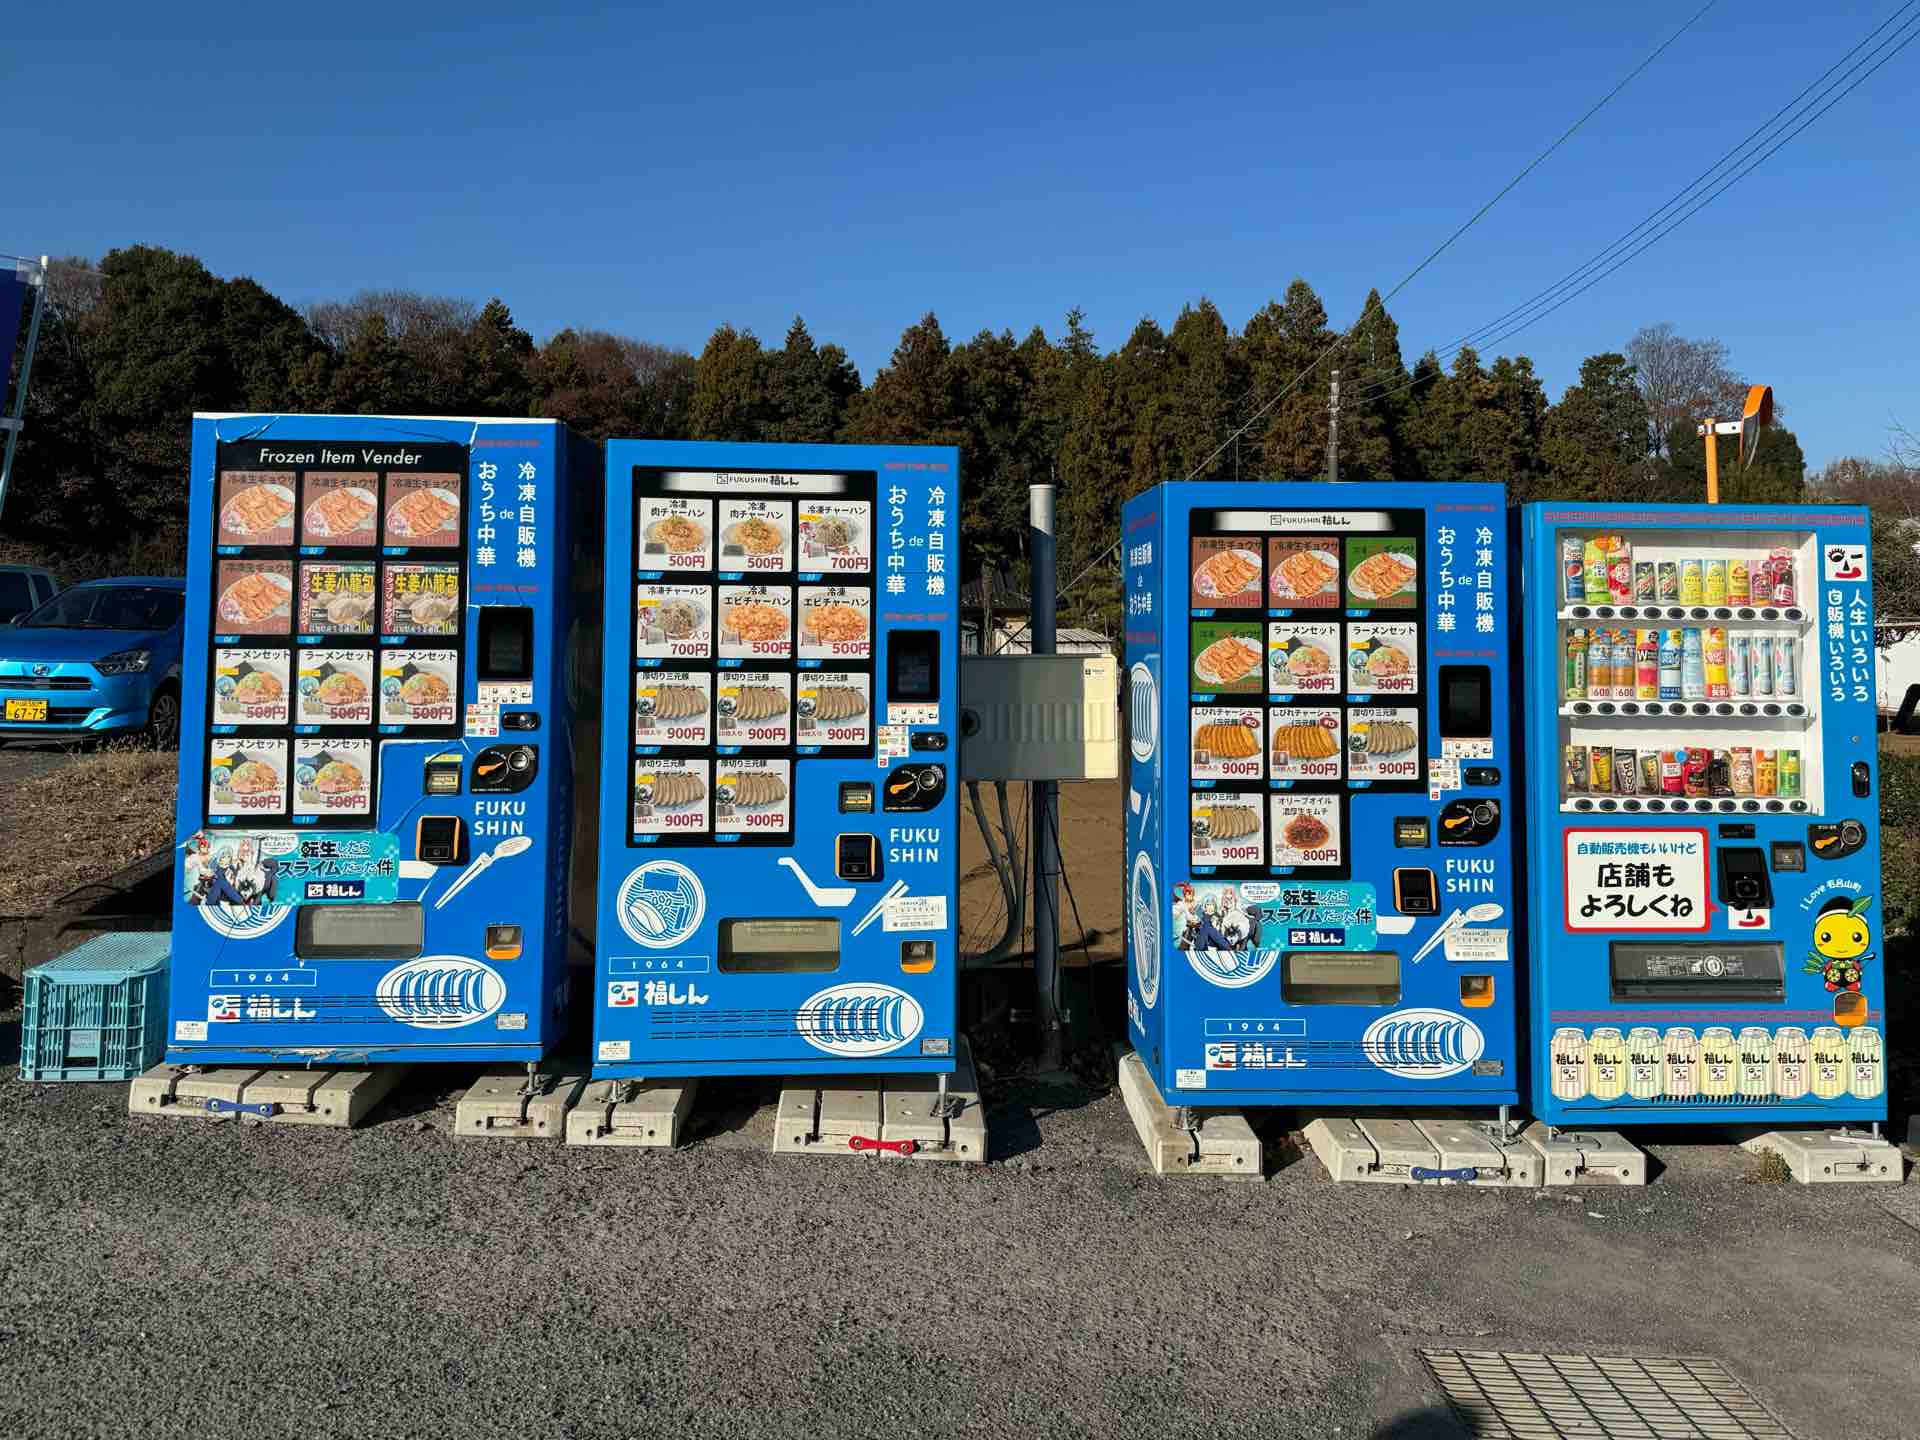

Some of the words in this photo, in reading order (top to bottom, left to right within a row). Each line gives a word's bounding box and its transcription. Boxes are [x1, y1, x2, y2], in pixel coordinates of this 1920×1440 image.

[259, 448, 315, 463] Frozen
[321, 448, 355, 464] Item
[362, 448, 422, 465] Vender
[729, 476, 768, 484] FUKUSHIN
[770, 475, 800, 486] 福しん
[669, 500, 687, 508] 冷凍
[748, 502, 767, 511] 冷凍
[808, 505, 867, 514] 冷凍チャーハン
[476, 461, 498, 567] おうち中華
[500, 508, 515, 520] de
[517, 461, 537, 568] 冷凍自販機
[651, 508, 705, 517] 肉チャーハン
[730, 510, 783, 520] 肉チャーハン
[1322, 515, 1351, 525] 福しん
[886, 485, 907, 596] おうち中華
[908, 536, 924, 546] de
[927, 485, 946, 596] 冷凍自販機
[669, 555, 705, 568] 500円
[747, 557, 784, 570] 500円
[831, 557, 868, 570] 700円
[311, 573, 374, 593] 生姜小籠包
[394, 574, 458, 596] 生姜小籠包
[1437, 525, 1456, 633] おうち中華
[1458, 575, 1473, 585] de
[1475, 526, 1495, 633] 冷凍自販機
[648, 586, 707, 595] 冷凍チャーハン
[748, 586, 767, 595] 冷凍
[827, 587, 846, 596] 冷凍
[724, 597, 791, 606] エビチャーハン
[804, 598, 869, 607] エビチャーハン
[1273, 626, 1336, 635] ラーメンセット
[1353, 626, 1415, 635] ラーメンセット
[671, 643, 708, 656] 700円
[752, 641, 791, 654] 500円
[832, 642, 870, 655] 500円
[1828, 589, 1845, 702] 自販機いろいろ
[1850, 588, 1869, 702] 人生いろいろ
[222, 650, 291, 660] ラーメンセット
[305, 650, 374, 661] ラーメンセット
[387, 651, 456, 661] ラーメンセット
[1297, 678, 1335, 691] 500円
[1377, 678, 1414, 690] 500円
[247, 706, 286, 719] 500円
[330, 706, 370, 720] 500円
[412, 706, 453, 720] 500円
[667, 728, 705, 740] 900円
[748, 728, 786, 740] 900円
[827, 728, 865, 741] 900円
[216, 740, 286, 749] ラーメンセット
[301, 740, 370, 749] ラーメンセット
[1222, 762, 1259, 776] 900円
[1301, 763, 1338, 776] 900円
[1378, 762, 1416, 776] 900円
[241, 795, 281, 808] 500円
[326, 795, 366, 808] 500円
[475, 801, 526, 816] FUKU
[665, 813, 704, 827] 900円
[746, 814, 784, 827] 900円
[474, 820, 523, 836] SHIN
[890, 828, 940, 842] FUKU
[1222, 847, 1259, 859] 900円
[1577, 842, 1697, 855] 自動販売機もいいけど
[890, 848, 938, 863] SHIN
[1303, 850, 1338, 861] 800円
[1446, 859, 1495, 874] FUKU
[1597, 863, 1675, 888] 店舗も
[326, 884, 361, 897] 福しん
[1446, 878, 1494, 893] SHIN
[1580, 894, 1693, 917] よろしくね
[1309, 931, 1342, 944] 福しん
[632, 960, 684, 969] 1964
[644, 980, 709, 1006] 福しん
[247, 994, 316, 1020] 福しん
[1227, 1022, 1280, 1031] 1964
[1242, 1043, 1307, 1069] 福しん
[1556, 1053, 1585, 1065] 福しん
[1593, 1053, 1622, 1065] 福しん
[1631, 1053, 1660, 1065] 福しん
[1667, 1053, 1696, 1065] 福しん
[1704, 1052, 1733, 1064] 福しん
[1741, 1052, 1770, 1064] 福しん
[1778, 1052, 1807, 1064] 福しん
[1814, 1052, 1843, 1064] 福しん
[1851, 1052, 1880, 1064] 福しん
